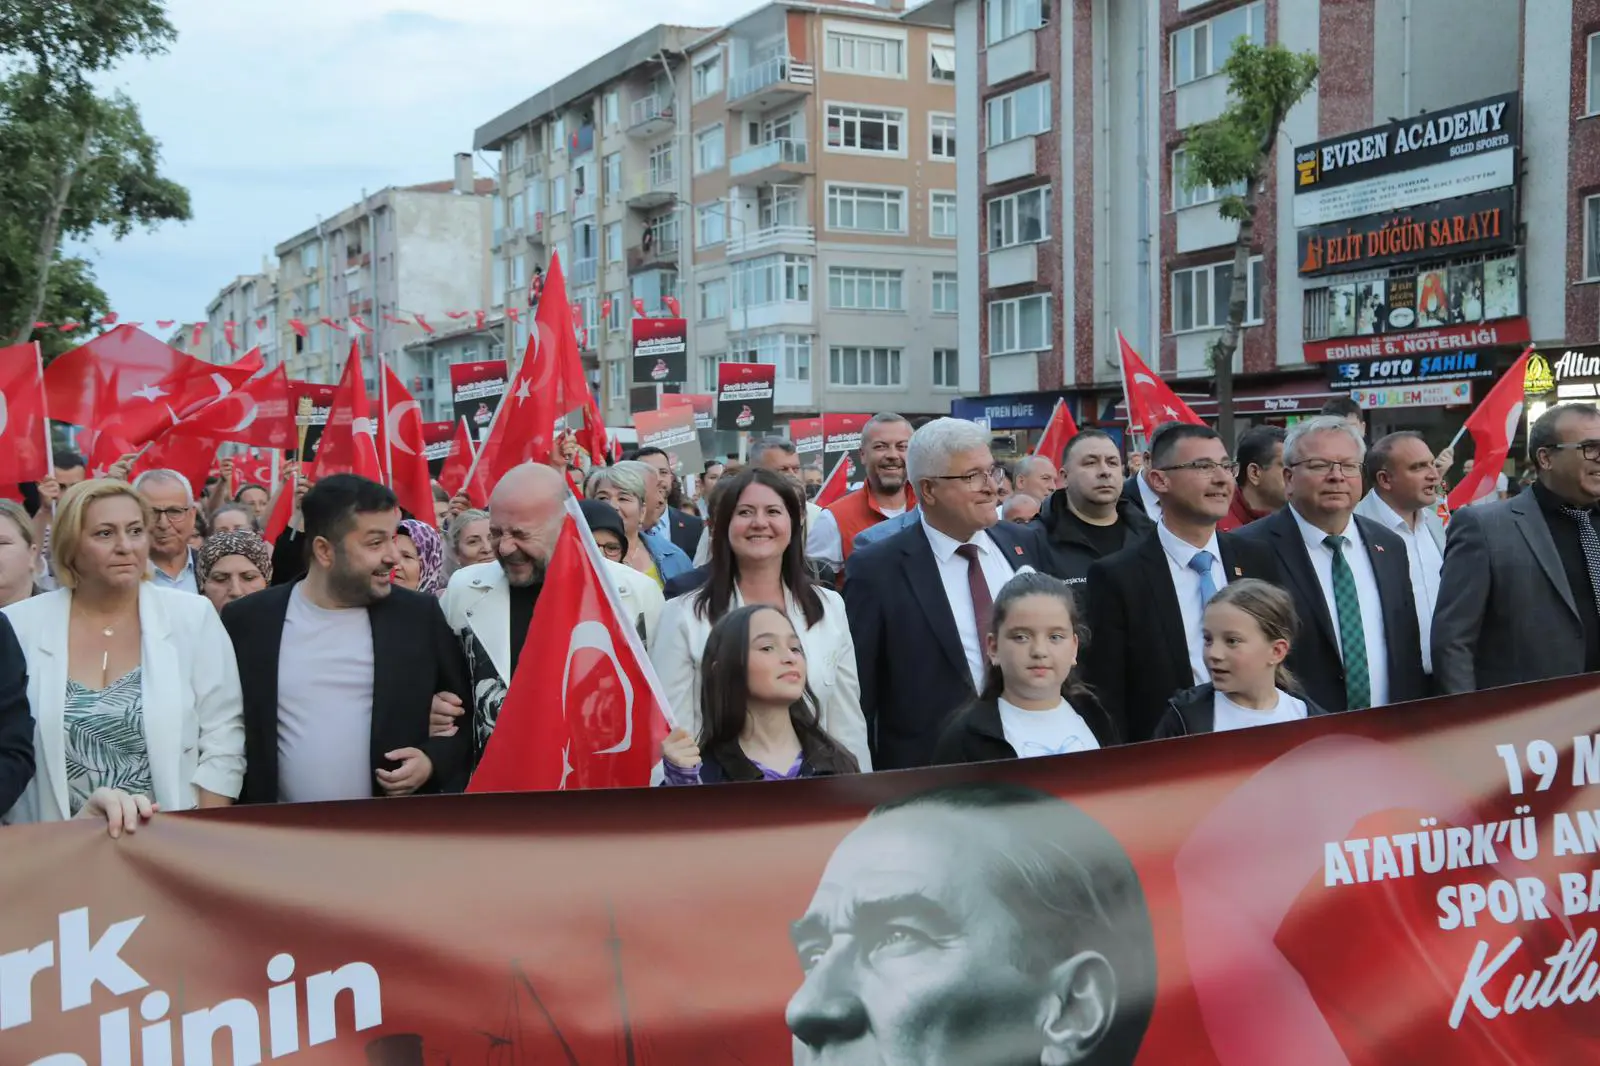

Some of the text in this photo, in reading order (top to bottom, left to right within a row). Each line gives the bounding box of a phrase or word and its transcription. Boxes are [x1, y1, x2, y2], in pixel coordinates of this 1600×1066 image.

[1322, 101, 1506, 172] EVREN ACADEMY
[1450, 134, 1510, 157] SOLID SPORTS
[1326, 207, 1501, 265] ELİT DÜĞÜN SARAYI
[1326, 328, 1498, 360] EDİRNE 6. NOTERLİĞİ
[1369, 358, 1413, 378] FOTO
[1420, 350, 1478, 378] ŞAHİN
[1554, 350, 1600, 381] Altın
[985, 403, 1034, 419] EVREN BÜFE
[1264, 398, 1300, 410] Day Today
[1369, 387, 1423, 406] BUĞLEM
[1495, 739, 1558, 795] 19
[1323, 805, 1539, 887] ATATÜRK'Ü
[1436, 876, 1551, 930] SPOR
[24, 952, 382, 1066] linin
